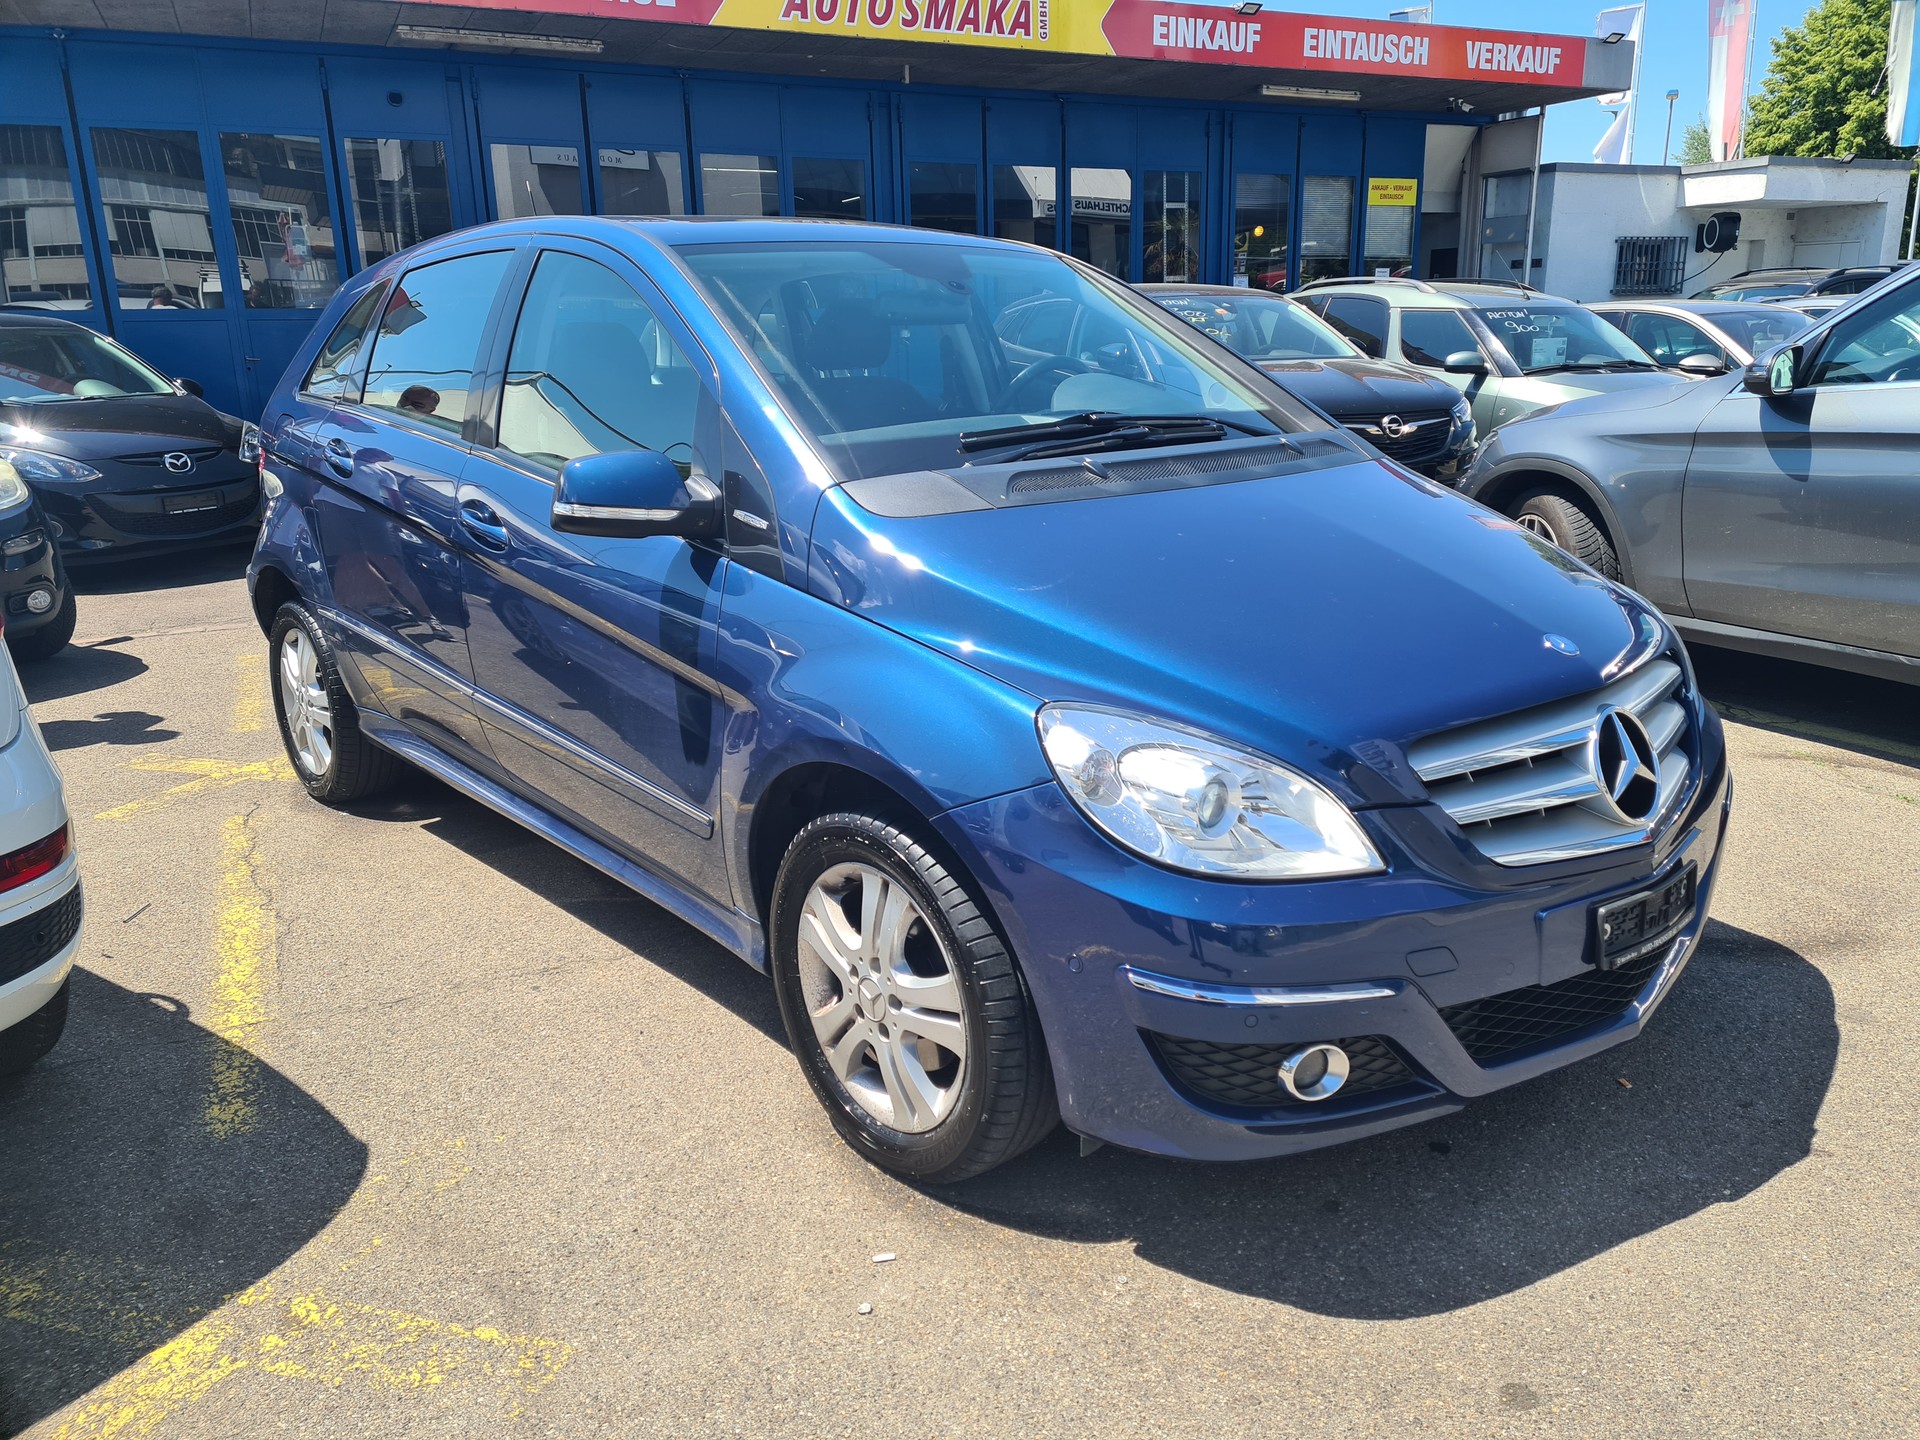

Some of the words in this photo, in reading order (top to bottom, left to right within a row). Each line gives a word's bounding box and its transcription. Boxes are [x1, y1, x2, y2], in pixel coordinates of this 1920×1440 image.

[1153, 14, 1262, 53] EINKAUF
[1303, 27, 1430, 66] EINTAUSCH
[1466, 40, 1562, 74] VERKAUF
